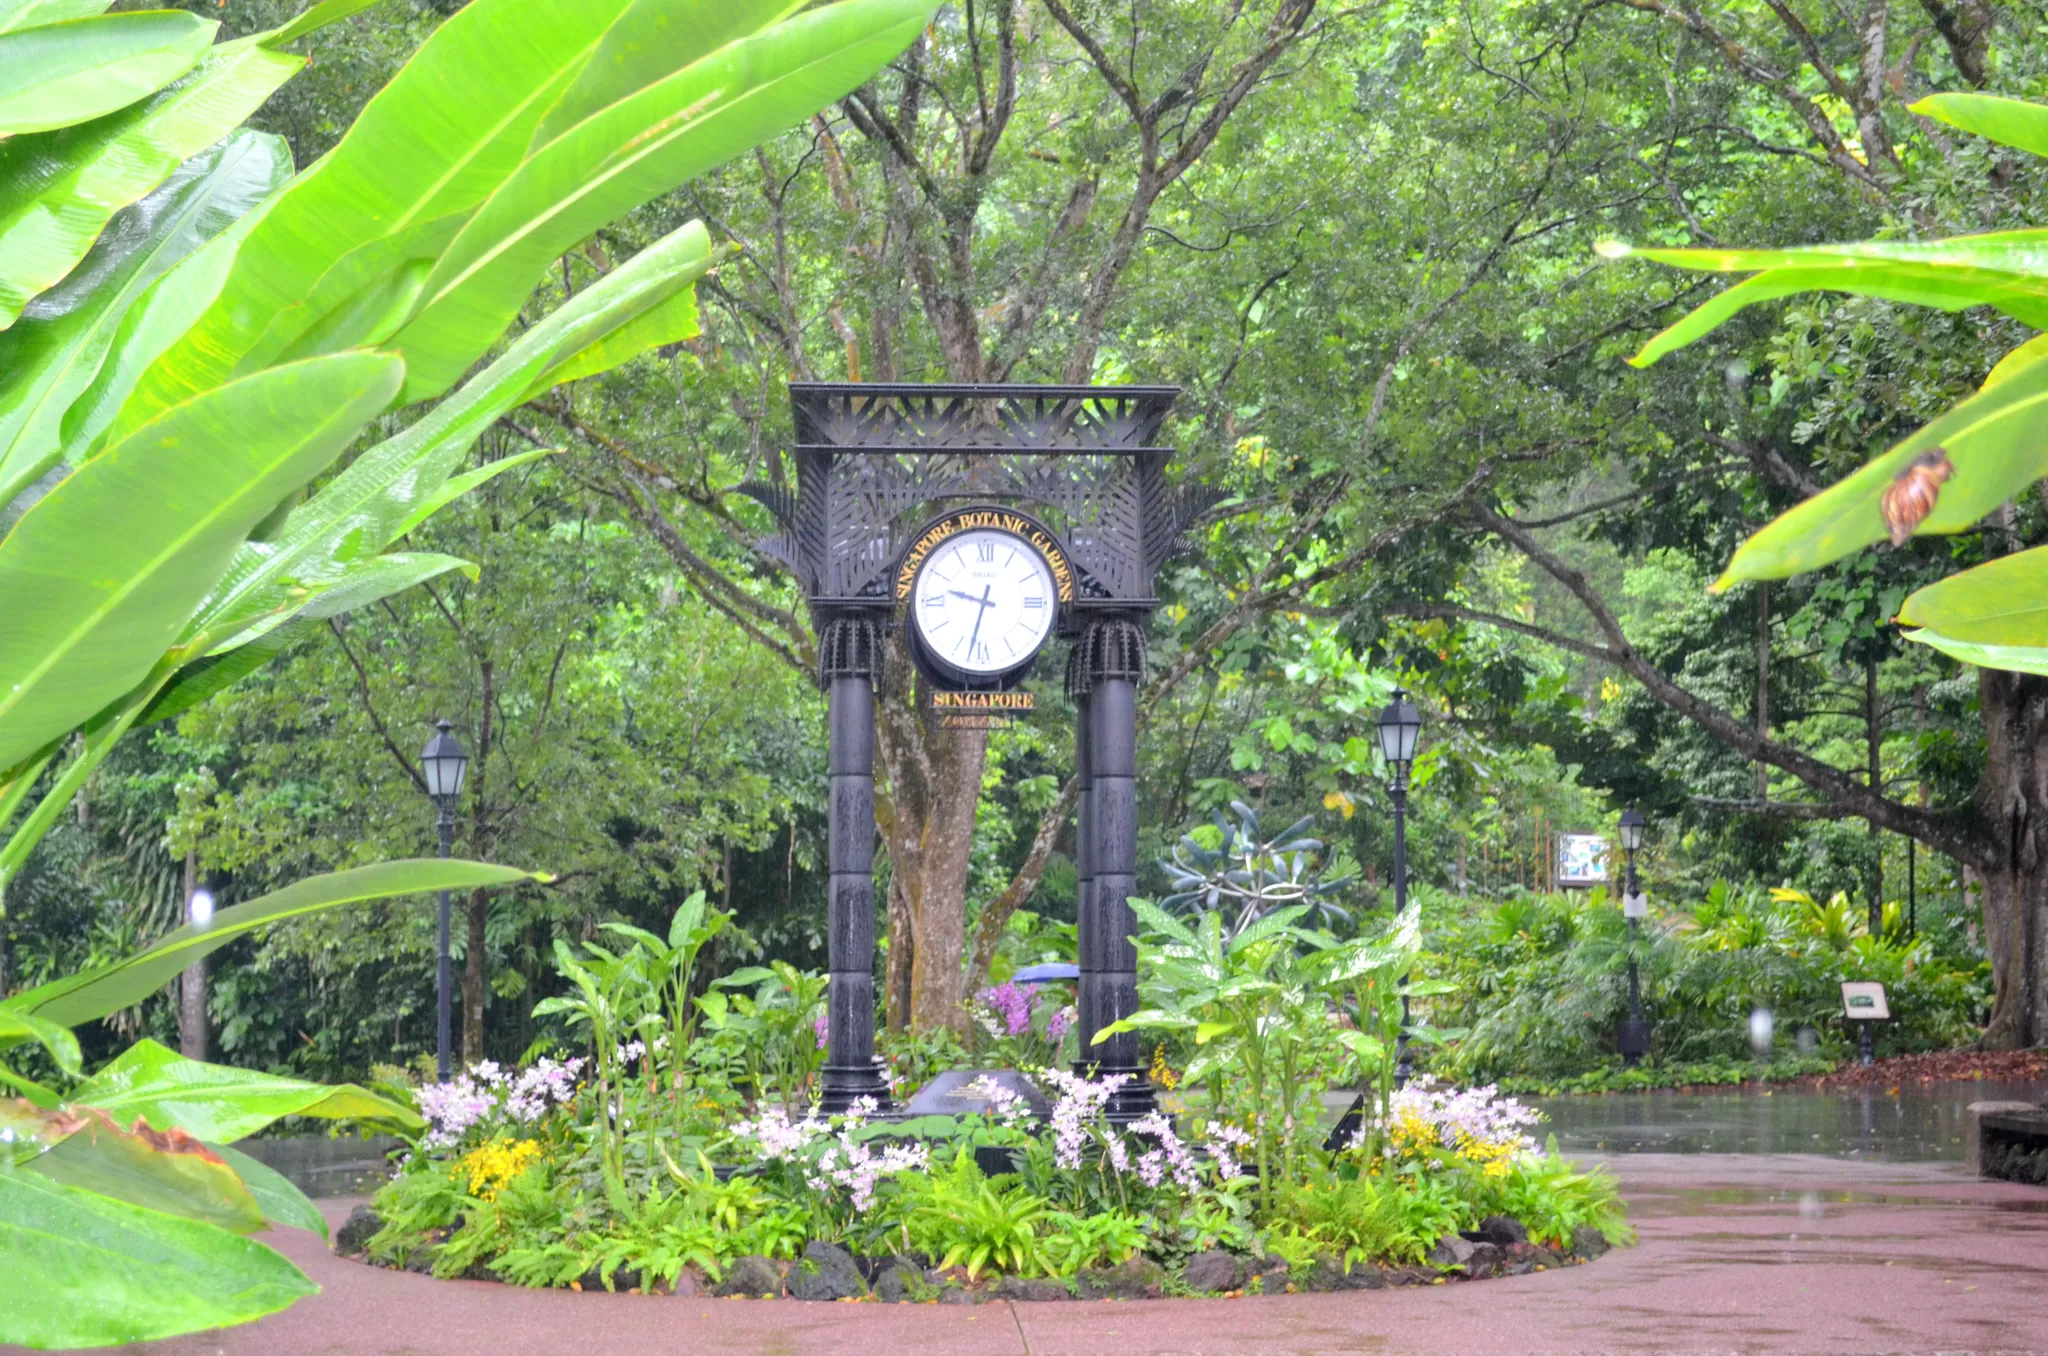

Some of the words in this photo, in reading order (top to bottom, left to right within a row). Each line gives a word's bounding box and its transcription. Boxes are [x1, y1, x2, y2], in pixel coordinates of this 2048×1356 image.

[896, 521, 955, 600] SINGAPORE
[959, 512, 1030, 531] BOTANIC
[1031, 531, 1073, 603] GARDENS
[977, 544, 994, 562] XII
[933, 693, 1034, 708] SINGAPORE
